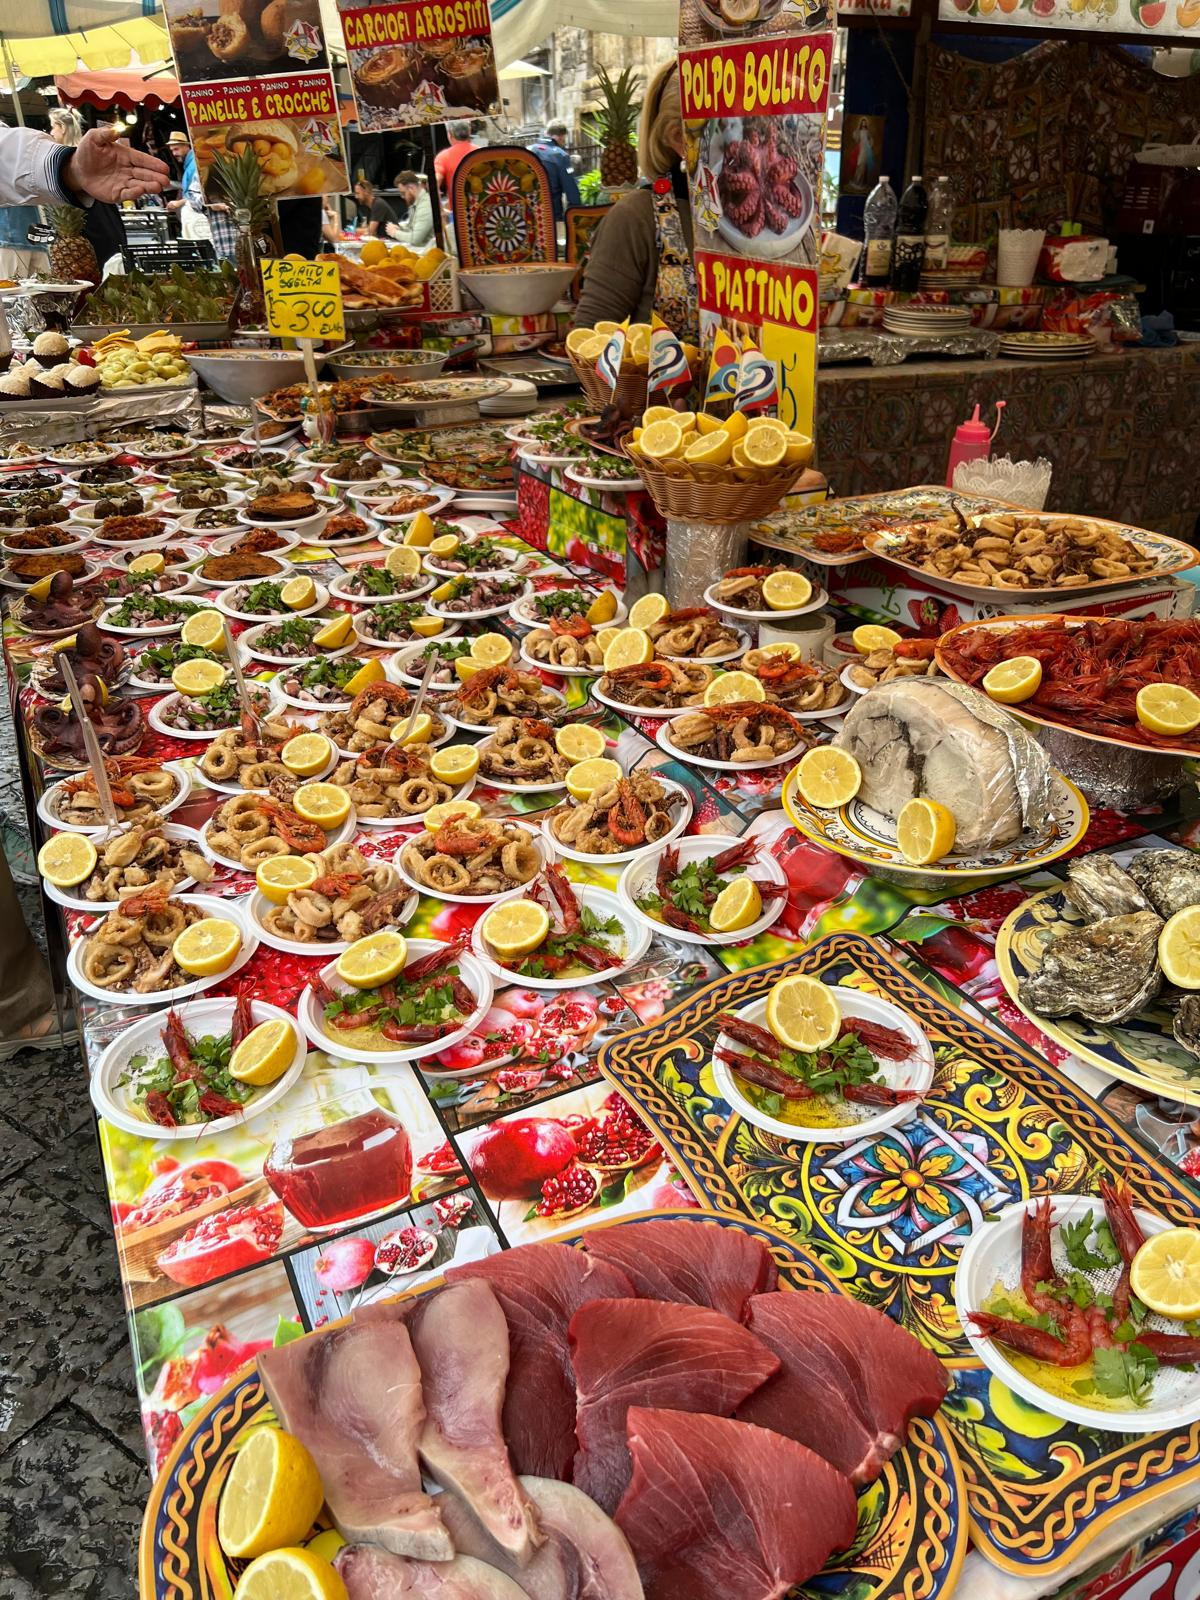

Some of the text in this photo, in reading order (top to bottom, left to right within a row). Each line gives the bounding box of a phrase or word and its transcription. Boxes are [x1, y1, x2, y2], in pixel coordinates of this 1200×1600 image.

[345, 0, 488, 46] CARCIOFI ARROSTITI
[185, 88, 214, 99] PANINO
[223, 84, 251, 95] PANINO
[260, 81, 289, 92] PANINO
[299, 78, 327, 88] PANINO
[681, 45, 826, 113] POLPO BOLLITO
[187, 98, 247, 125] PANELLE
[252, 97, 261, 119] E
[712, 261, 815, 327] PIATTINO
